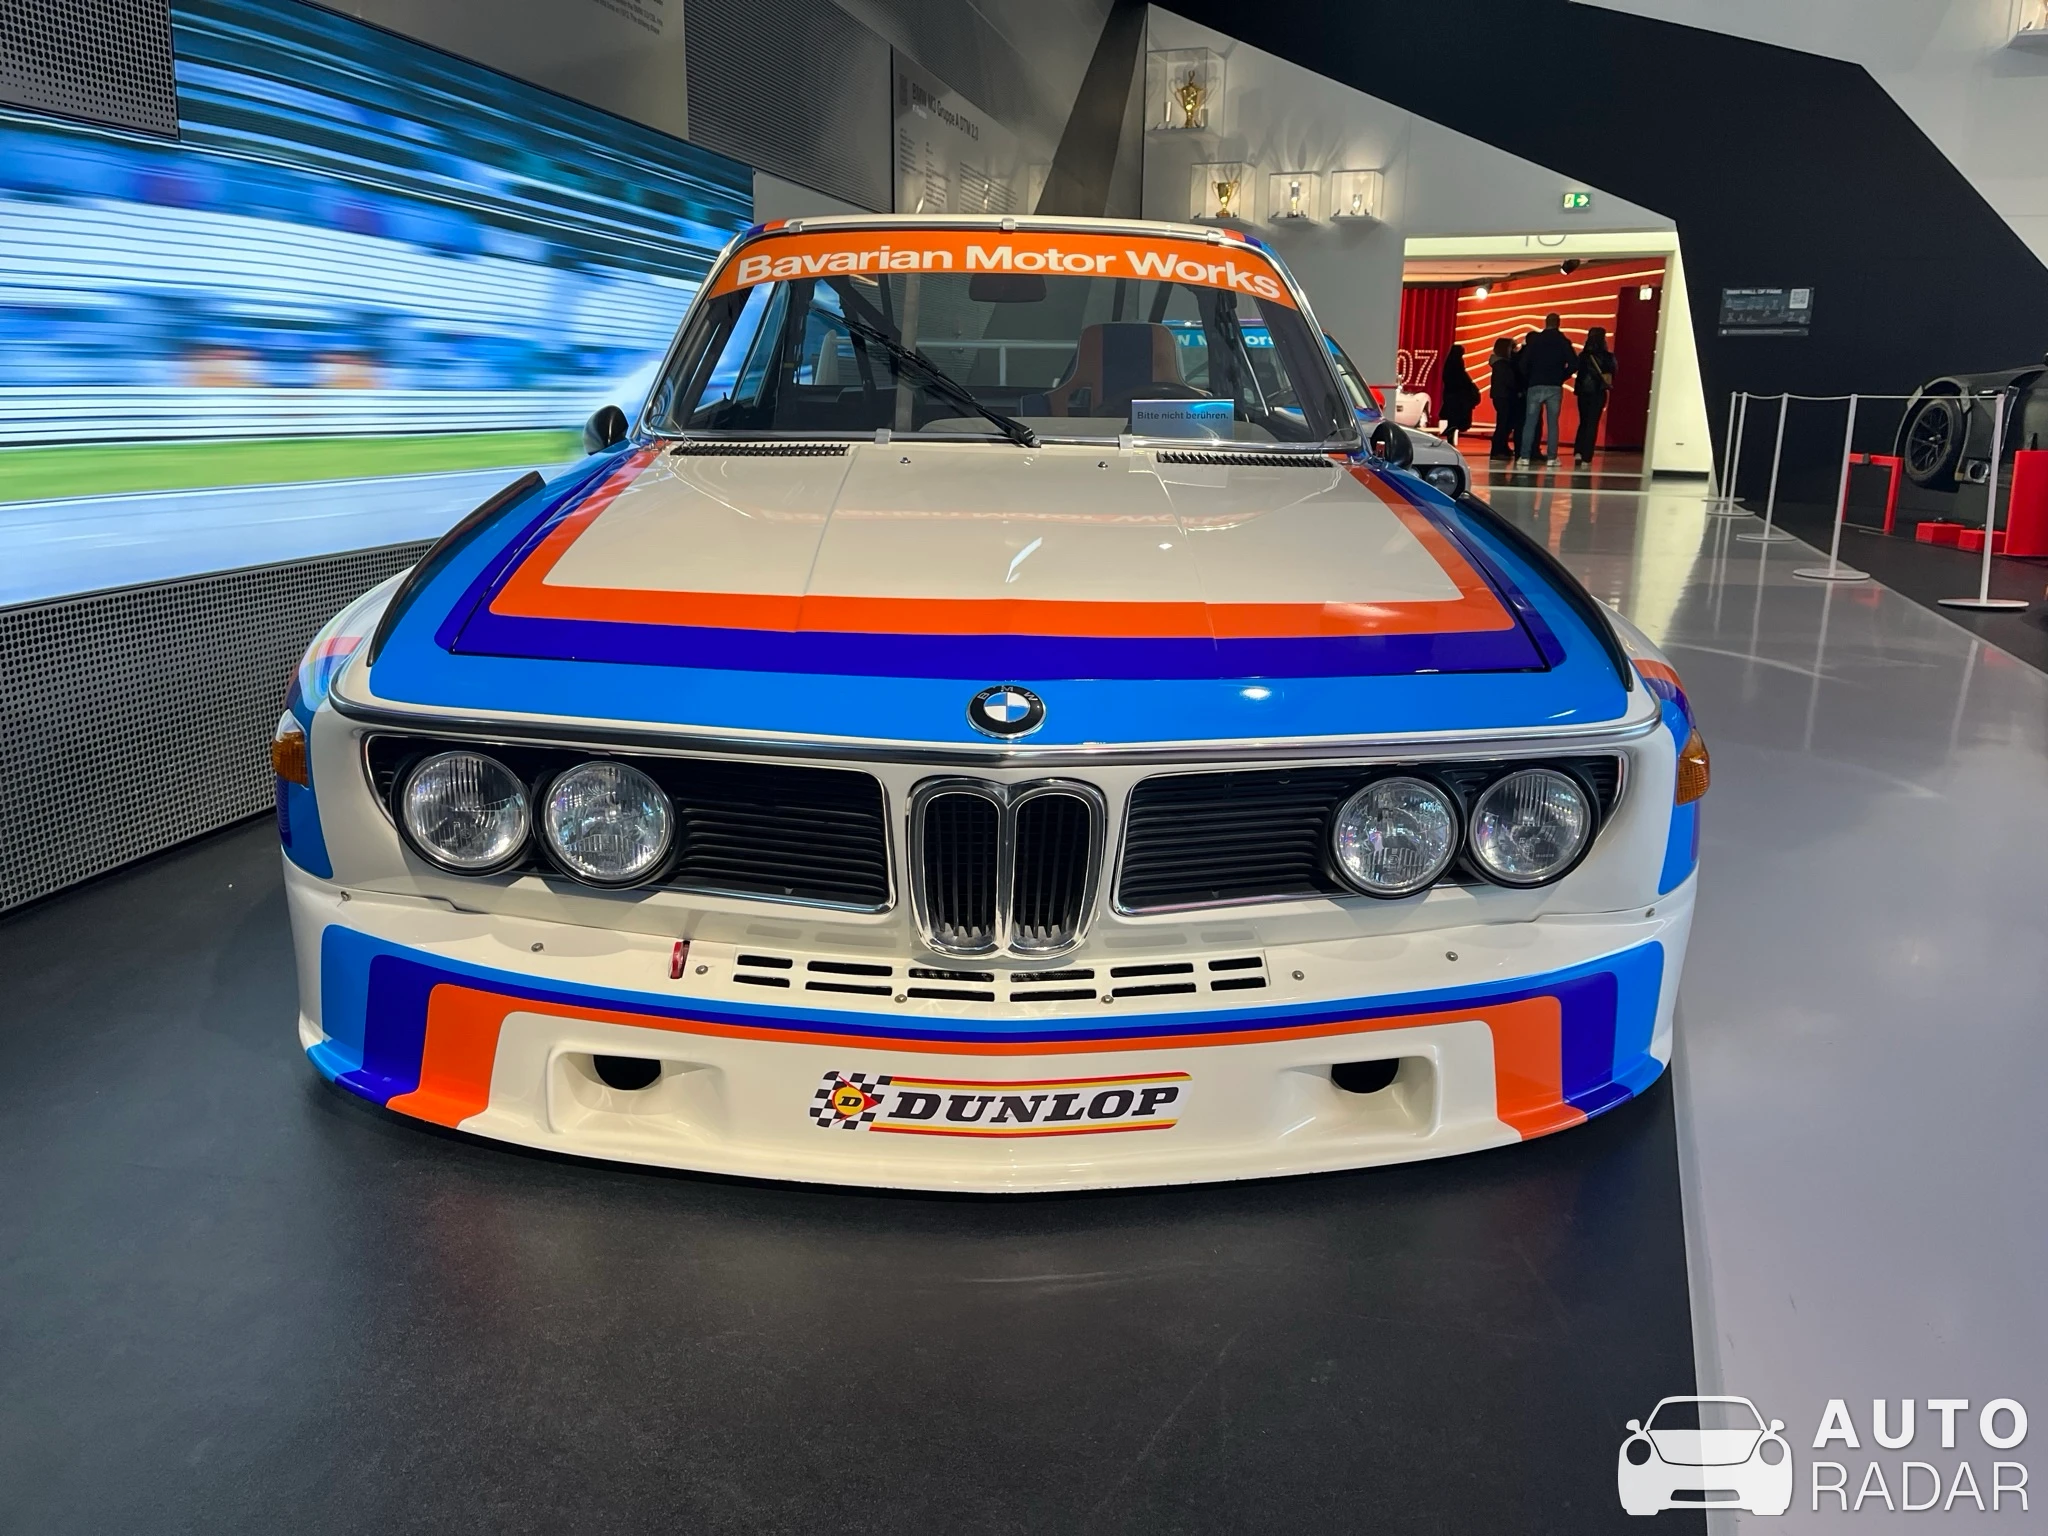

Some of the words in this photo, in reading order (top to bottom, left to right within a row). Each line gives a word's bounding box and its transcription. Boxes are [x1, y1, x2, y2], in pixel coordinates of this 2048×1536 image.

[736, 245, 953, 286] Bavarian
[966, 246, 1117, 273] Motor
[1125, 250, 1281, 299] Works
[1137, 411, 1160, 419] Bitte
[1161, 411, 1184, 419] nicht
[1186, 411, 1229, 419] berühren.
[977, 685, 1039, 701] BMW
[838, 1096, 862, 1107] D
[888, 1086, 1180, 1123] DUNLOP
